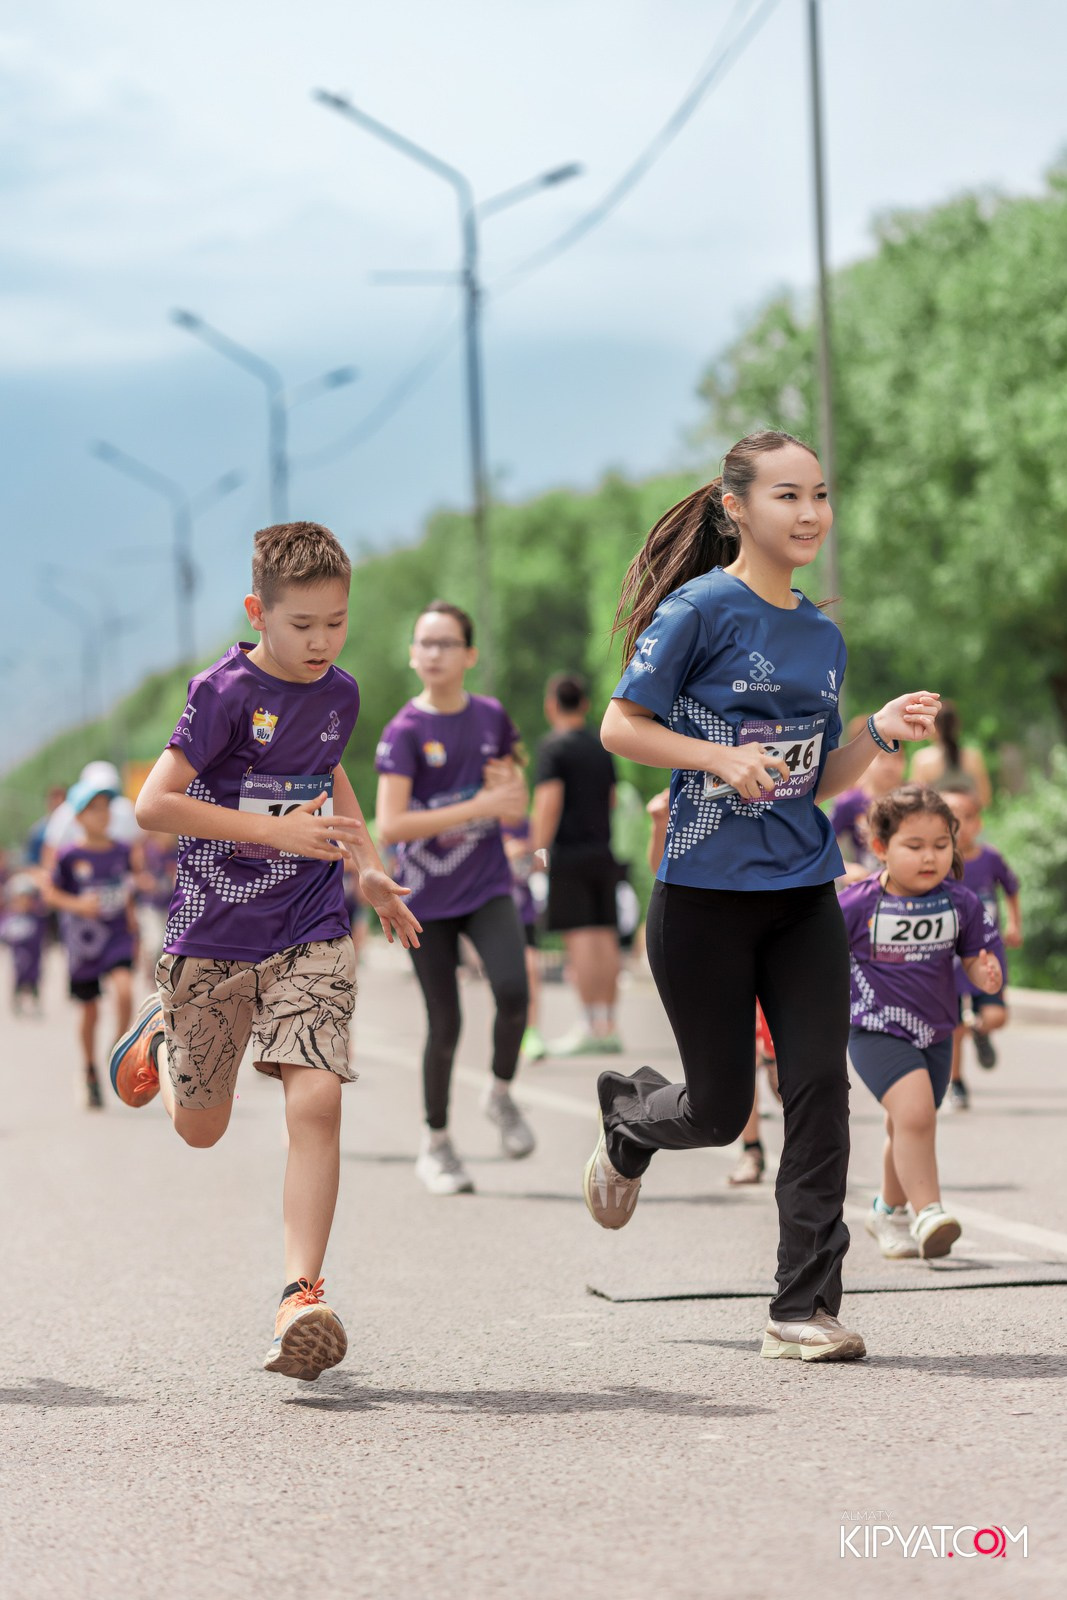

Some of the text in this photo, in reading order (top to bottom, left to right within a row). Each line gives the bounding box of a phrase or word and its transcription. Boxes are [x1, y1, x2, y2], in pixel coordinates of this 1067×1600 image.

[749, 682, 781, 692] GROUP
[764, 740, 815, 772] 46
[774, 788, 793, 797] 600
[891, 917, 943, 941] 201
